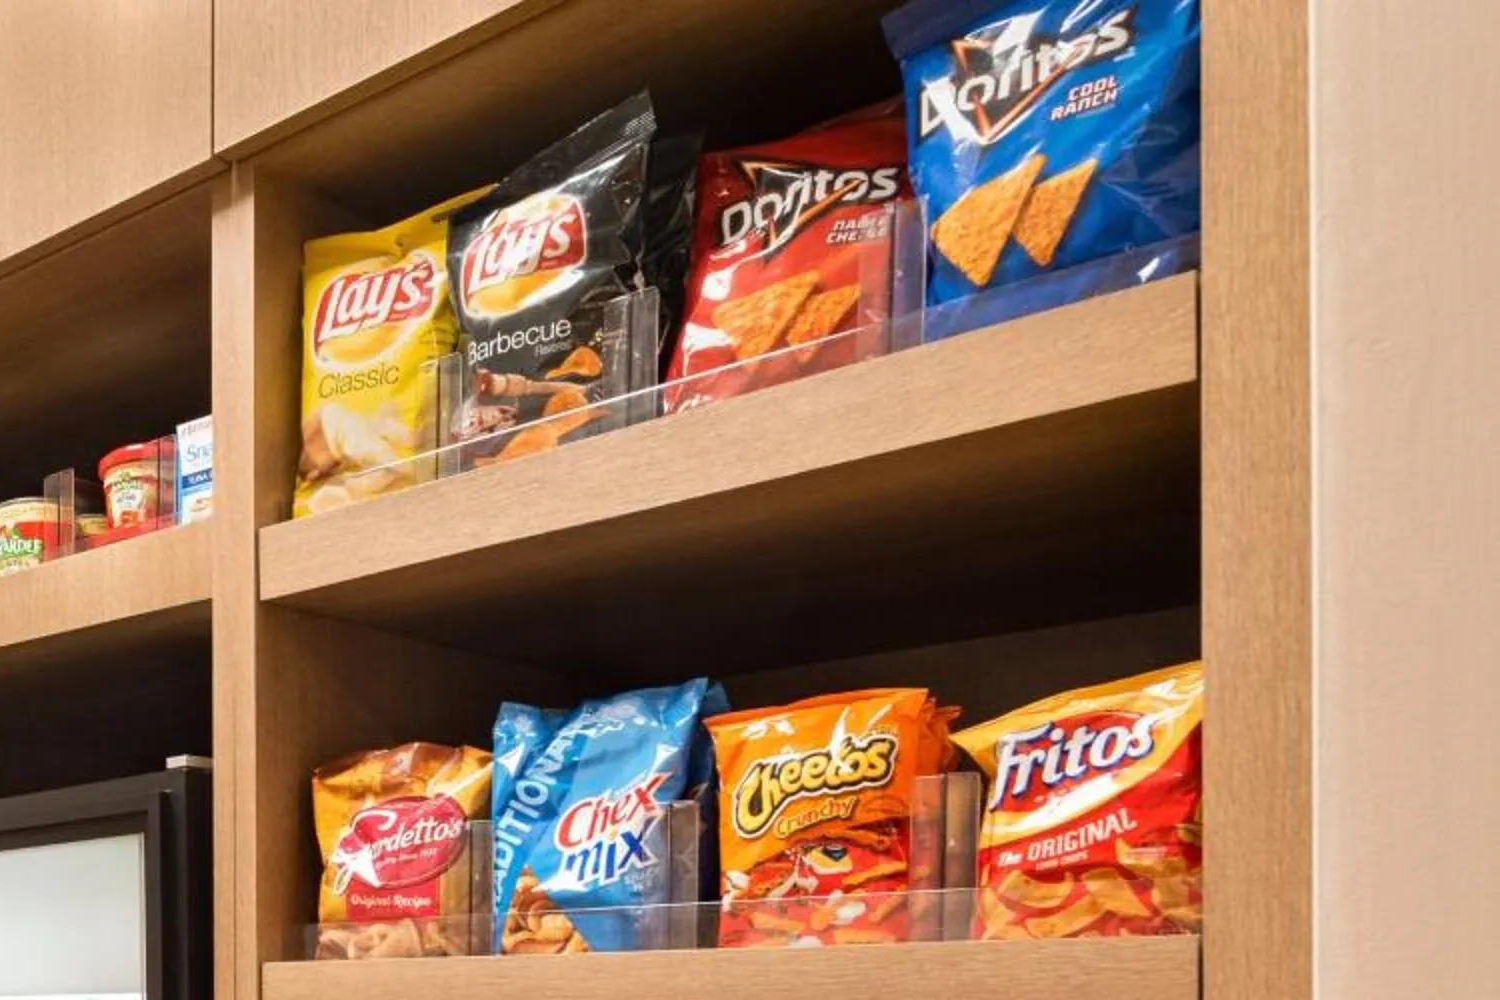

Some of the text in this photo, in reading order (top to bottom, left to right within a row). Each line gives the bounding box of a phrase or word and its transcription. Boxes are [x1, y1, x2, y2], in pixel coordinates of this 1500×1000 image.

[919, 6, 1133, 137] Doritos
[1067, 76, 1119, 102] COOL
[1049, 88, 1119, 121] RANCH
[719, 167, 898, 247] Doritos
[467, 318, 572, 366] Barbecue
[317, 364, 400, 399] Classic
[735, 737, 895, 835] Cheetos
[989, 715, 1158, 811] Fritos
[555, 772, 672, 850] Chex
[774, 796, 858, 839] Crunchy
[1026, 808, 1138, 861] ORIGINAL
